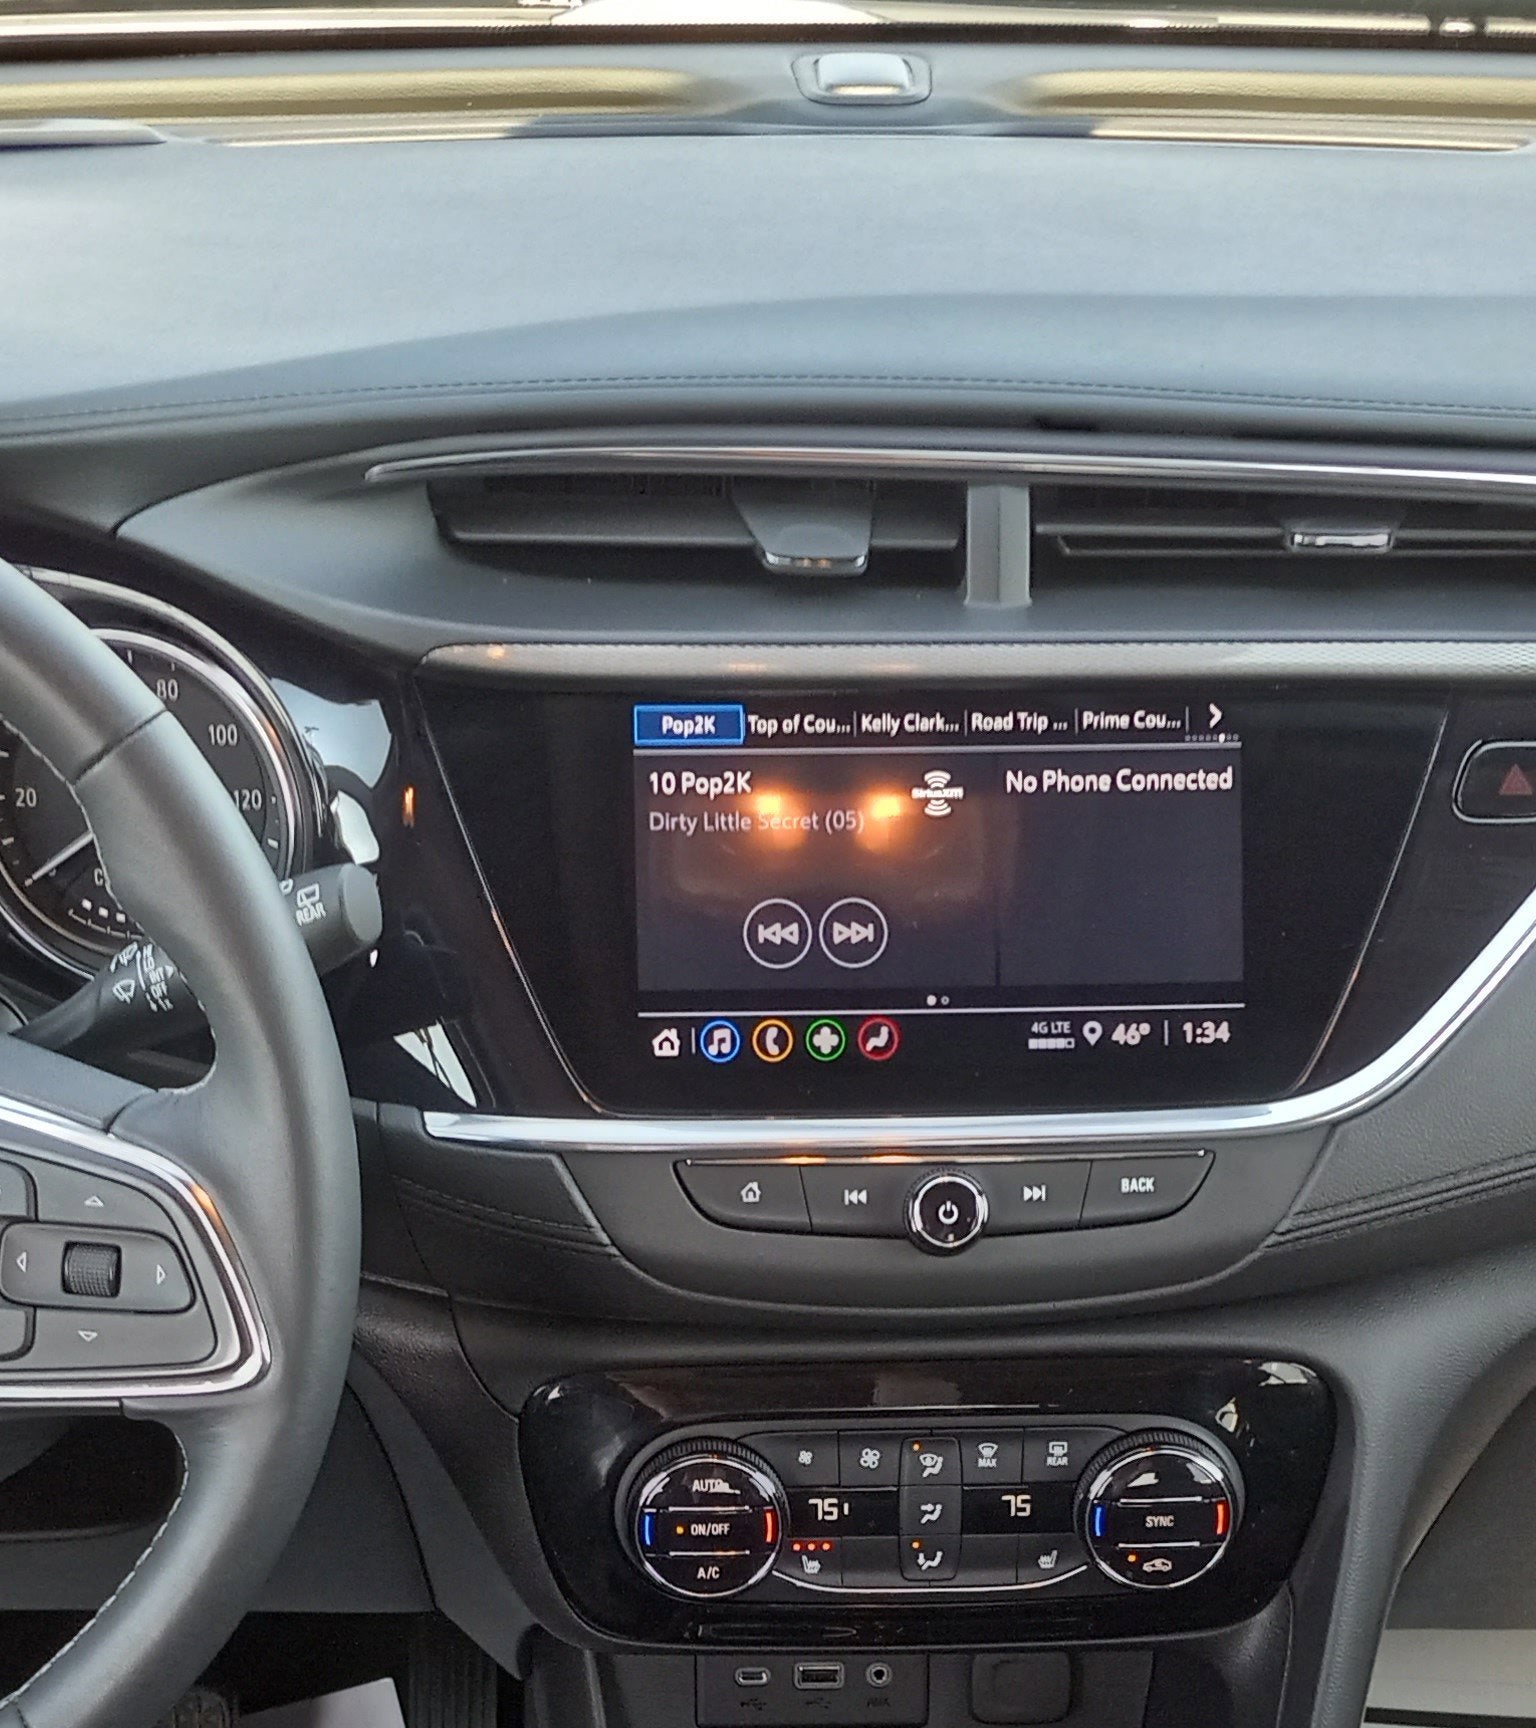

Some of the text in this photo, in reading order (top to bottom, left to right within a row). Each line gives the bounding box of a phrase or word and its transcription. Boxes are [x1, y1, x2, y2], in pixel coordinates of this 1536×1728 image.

[156, 678, 179, 702] 80
[662, 715, 716, 738] Pop2K
[749, 714, 779, 738] Top
[784, 714, 799, 733] of
[861, 713, 900, 736] Kelly
[971, 712, 1013, 731] Road
[1017, 711, 1048, 733] Trip
[1082, 710, 1129, 730] Prime
[208, 723, 238, 746] 100
[649, 771, 752, 799] 10 Pop2K
[1006, 767, 1234, 793] No Phone Connected
[15, 788, 37, 808] 20
[233, 788, 262, 811] 120
[649, 810, 866, 835] Dirty Little Secret (05)
[296, 902, 327, 927] REAR
[1031, 1021, 1071, 1034] 4G LTE
[1183, 1022, 1230, 1046] 1:34
[1121, 1177, 1155, 1193] BACK
[978, 1457, 997, 1468] MAX
[1047, 1456, 1069, 1467] REAR
[808, 1498, 839, 1521] 75
[1001, 1495, 1031, 1517] 75
[690, 1523, 730, 1537] ON/OFF
[1146, 1514, 1175, 1528] SYNC
[697, 1566, 720, 1580] A/C
